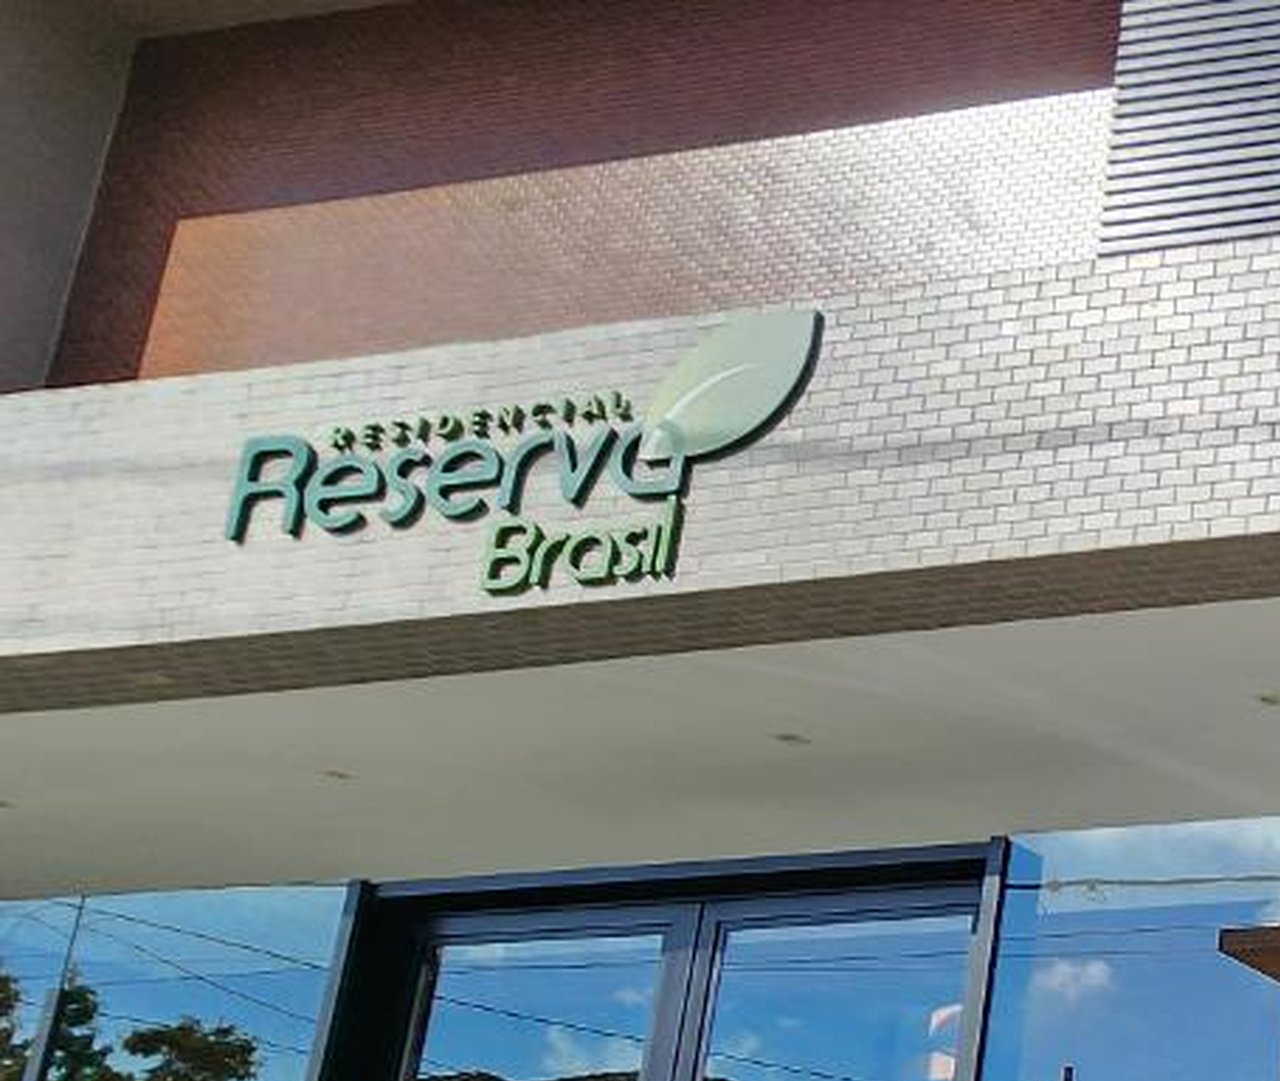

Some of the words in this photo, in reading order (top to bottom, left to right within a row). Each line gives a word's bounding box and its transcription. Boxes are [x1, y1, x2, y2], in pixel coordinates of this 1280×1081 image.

[328, 390, 634, 451] RESIDENCIAL
[225, 422, 688, 545] Reserva
[483, 494, 684, 595] Brasil
